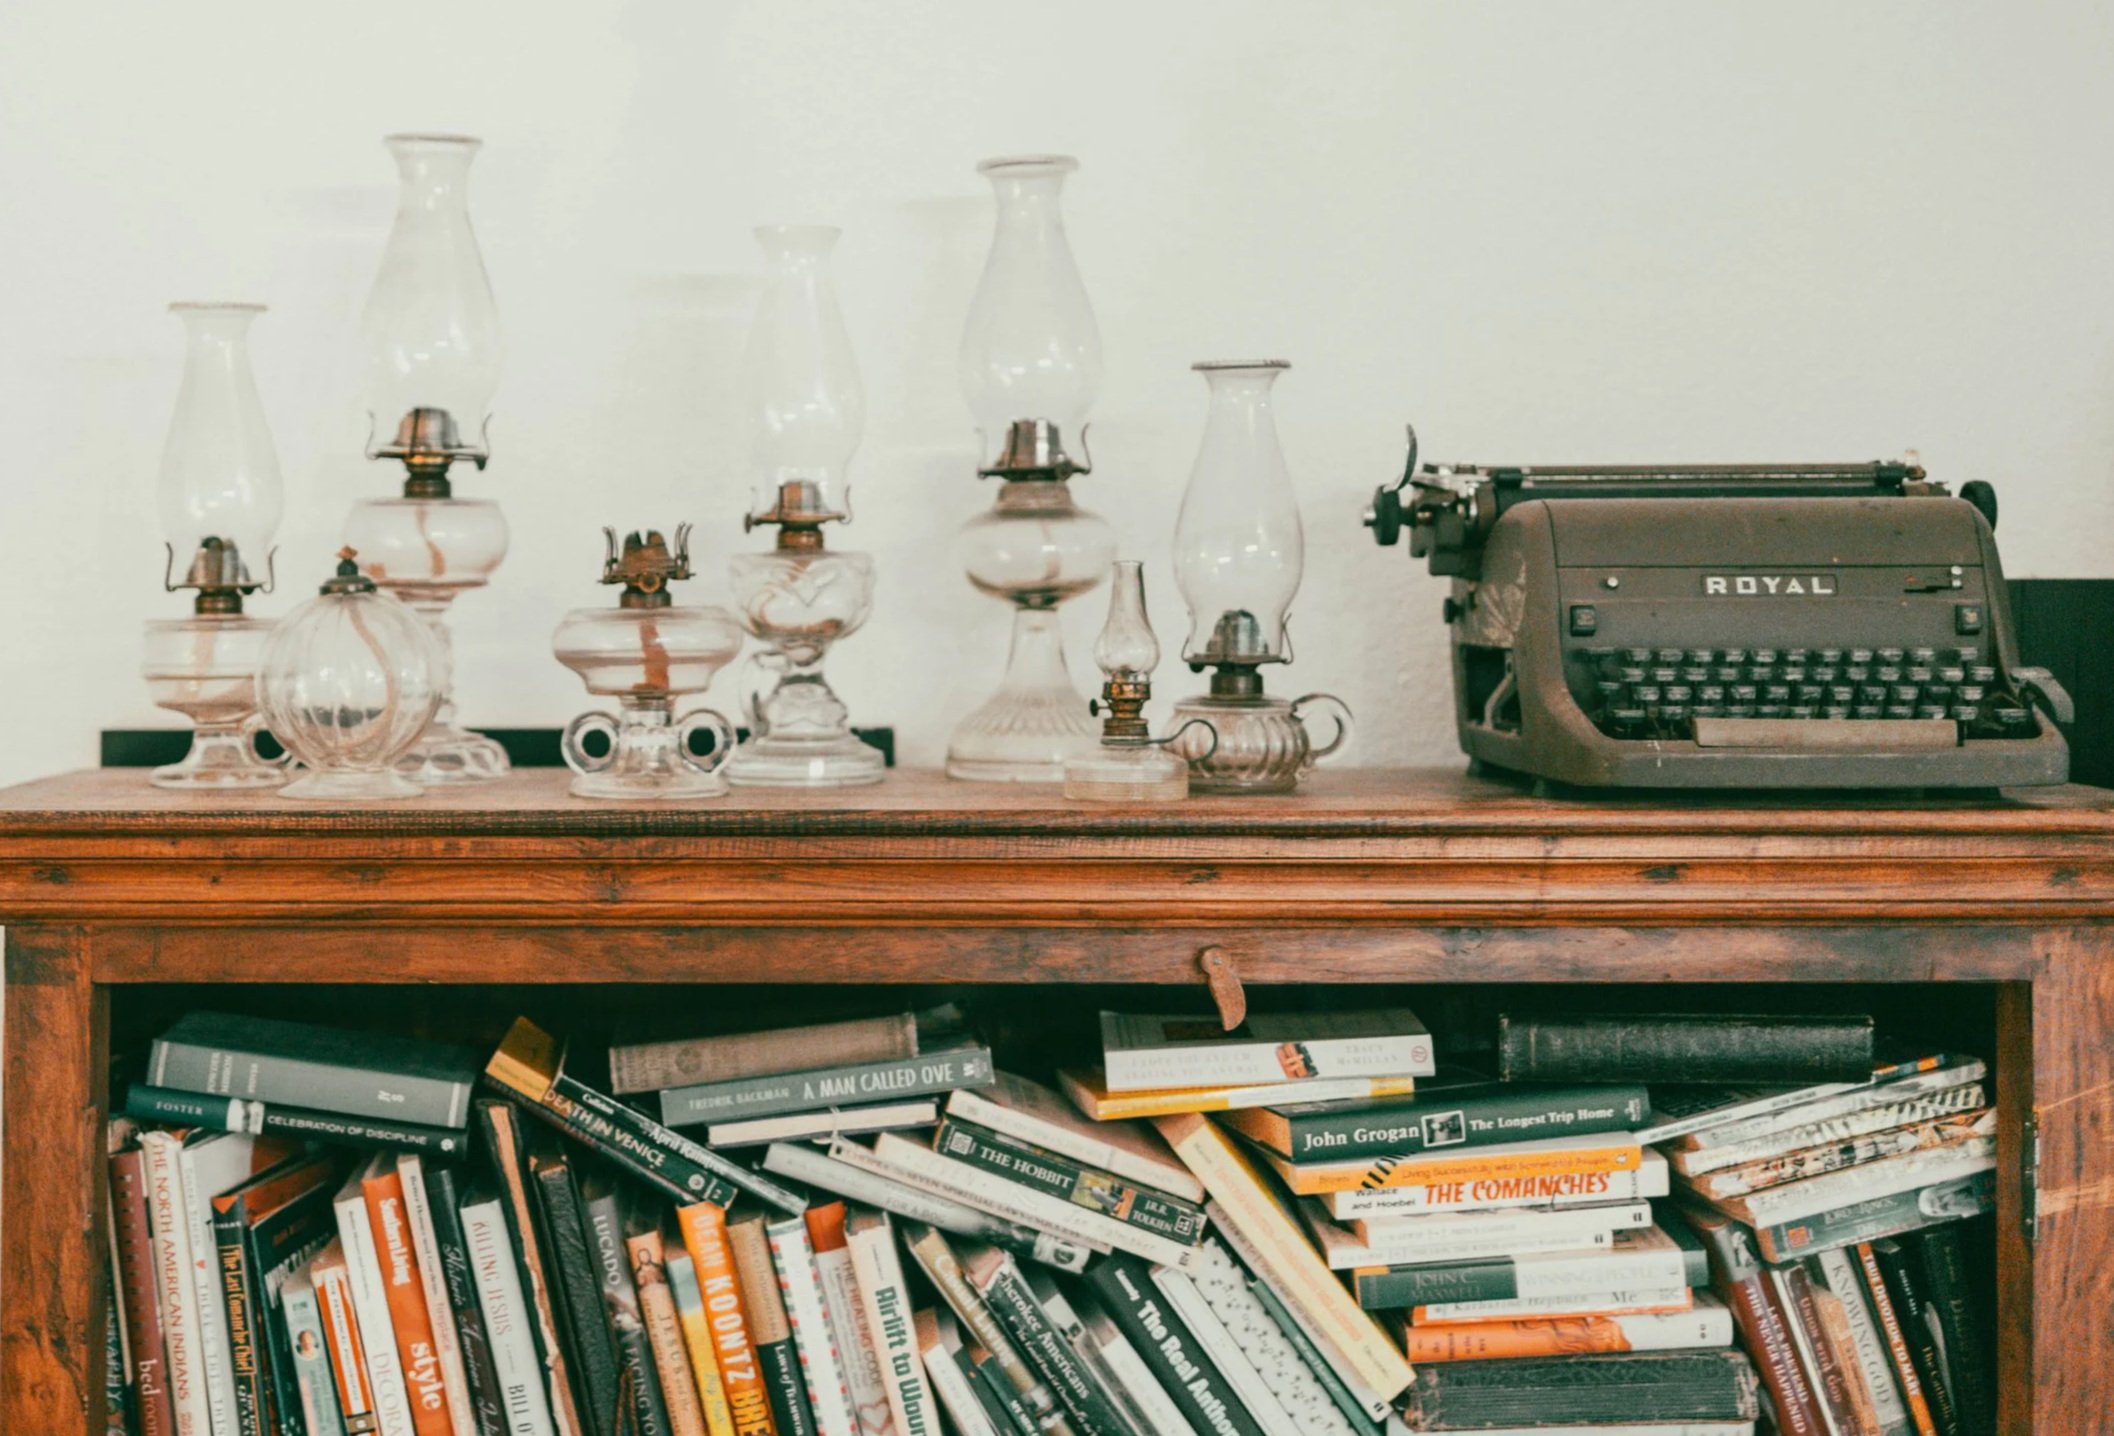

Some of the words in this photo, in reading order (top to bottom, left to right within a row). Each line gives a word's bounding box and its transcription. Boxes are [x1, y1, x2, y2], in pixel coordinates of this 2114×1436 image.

[1706, 576, 1833, 594] ROYAL
[688, 1093, 733, 1112] FREDRIK
[736, 1085, 789, 1105] BACKMAN
[801, 1083, 814, 1100] A
[817, 1076, 856, 1099] MAN
[859, 1066, 917, 1095] CALLED
[920, 1062, 953, 1085] OVE
[155, 1100, 203, 1115] FOSTER
[1469, 1117, 1493, 1131] The
[1497, 1112, 1545, 1131] Longest
[1548, 1110, 1574, 1125] Trip
[1577, 1106, 1614, 1120] Home
[267, 1114, 344, 1133] CELEBRATION
[347, 1125, 363, 1136] OF
[366, 1128, 427, 1145] DISCIPLINE
[543, 1088, 594, 1124] DEATH
[591, 1117, 613, 1136] IN
[611, 1128, 666, 1166] VENICE
[1303, 1129, 1347, 1151] John
[1353, 1121, 1420, 1146] Grogan
[151, 1143, 166, 1171] THE
[977, 1145, 1012, 1168] THE
[1012, 1158, 1072, 1190] HOBBIT
[1402, 1168, 1431, 1180] Living
[1432, 1162, 1493, 1178] Successfully
[1495, 1161, 1517, 1172] with
[409, 1175, 422, 1202] Better
[905, 1170, 942, 1190] SEVEN
[1355, 1186, 1397, 1197] Wallace
[1424, 1181, 1464, 1204] THE
[1471, 1169, 1610, 1202] COMANCHES
[154, 1177, 171, 1233] NORTH
[378, 1196, 407, 1249] Southern
[413, 1203, 429, 1235] Homes
[1131, 1209, 1173, 1233] TOLKIEN
[1351, 1201, 1372, 1210] and
[1376, 1197, 1415, 1208] Hoebel
[223, 1249, 240, 1269] The
[420, 1236, 432, 1255] and
[470, 1219, 501, 1282] KILLING
[591, 1214, 622, 1286] LUCADO
[691, 1212, 725, 1269] DEAN
[161, 1238, 181, 1327] AMERICAN
[224, 1270, 244, 1292] Last
[386, 1247, 413, 1286] Living
[423, 1255, 441, 1295] Gardens
[439, 1240, 475, 1306] Historic
[840, 1259, 856, 1281] THE
[1415, 1270, 1458, 1287] JOHN
[1864, 1253, 1882, 1284] TRUE
[485, 1287, 513, 1336] JESUS
[931, 1252, 981, 1312] Casual
[973, 1309, 1017, 1368] Living
[1411, 1286, 1480, 1301] MAXWELL
[1610, 1289, 1636, 1303] Me
[226, 1293, 250, 1344] Comanche
[702, 1273, 756, 1387] KOONTZ
[846, 1287, 874, 1347] HEALING
[875, 1286, 908, 1349] Airlift
[892, 1352, 913, 1376] to
[1830, 1263, 1878, 1357] KNOWING
[1865, 1358, 1896, 1404] GOD
[1874, 1284, 1903, 1345] DEVOTION
[455, 1310, 494, 1388] American
[657, 1310, 686, 1375] JESUS
[993, 1269, 1046, 1333] Cherokee
[1036, 1328, 1094, 1399] Americans
[1133, 1299, 1173, 1341] The
[1157, 1333, 1201, 1381] Real
[1895, 1345, 1908, 1361] TO
[171, 1331, 190, 1400] INDIANS
[233, 1344, 253, 1371] Chief
[863, 1349, 883, 1388] CODE
[1744, 1285, 1766, 1317] THIS
[1756, 1318, 1781, 1362] NEVER
[1772, 1363, 1807, 1434] HAPPENED
[1765, 1305, 1786, 1341] LET'S
[1779, 1342, 1809, 1403] PRETEND
[1921, 1345, 1938, 1368] The
[401, 1339, 447, 1412] style
[623, 1346, 652, 1409] FACING
[777, 1372, 795, 1387] of
[1900, 1361, 1921, 1396] MARY
[1927, 1369, 1955, 1419] Catholic
[506, 1383, 530, 1415] BILL
